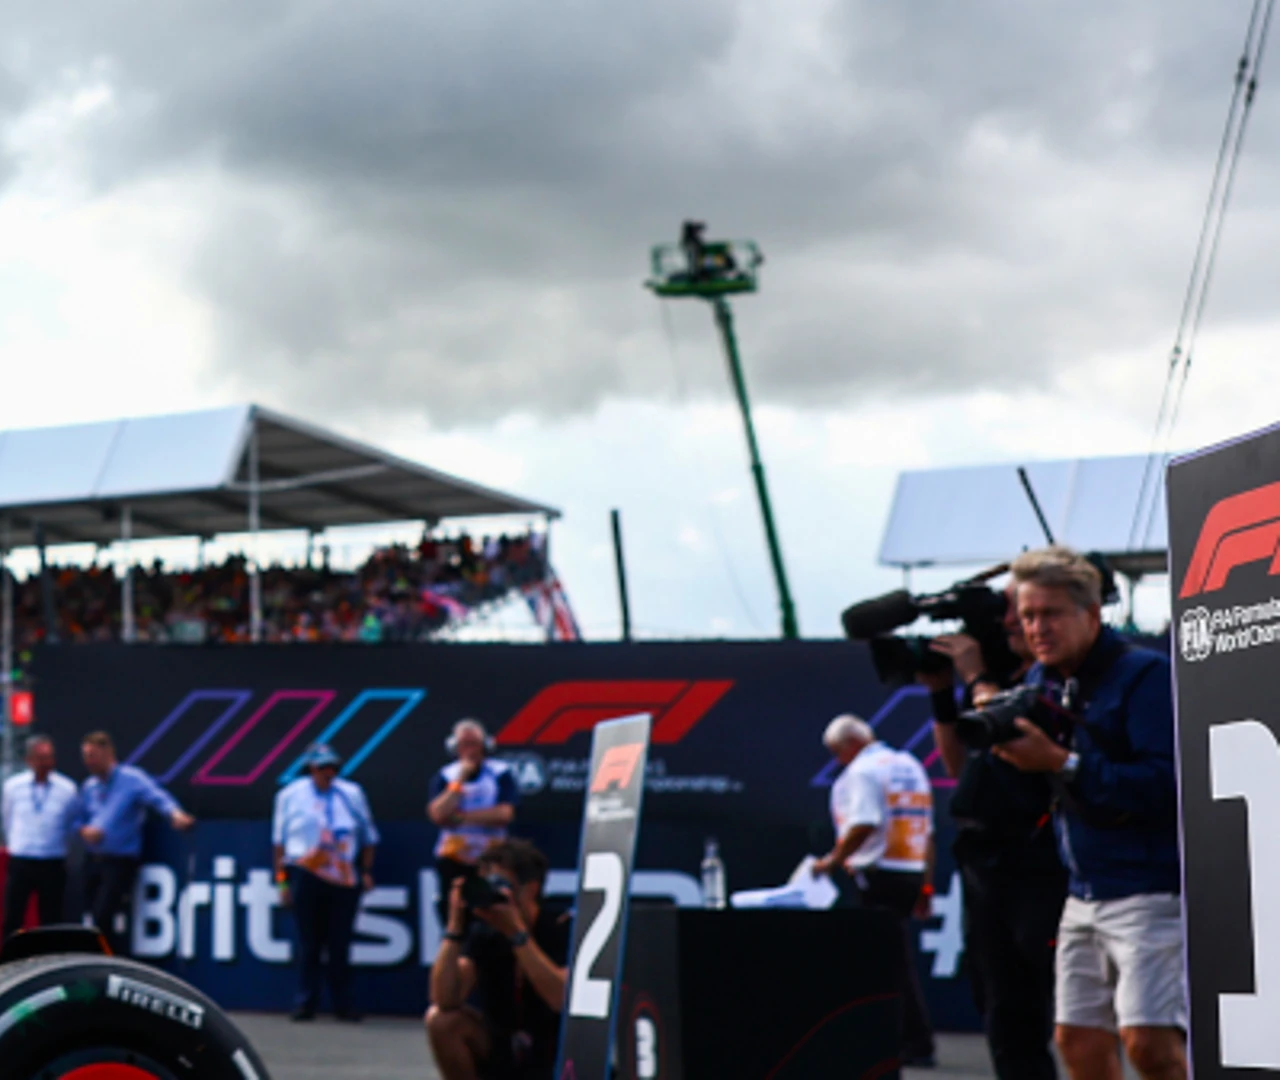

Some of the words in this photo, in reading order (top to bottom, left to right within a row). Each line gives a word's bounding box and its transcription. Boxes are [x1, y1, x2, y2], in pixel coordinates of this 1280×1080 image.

[132, 855, 444, 966] Brits
[568, 851, 624, 1019] 2
[1209, 719, 1280, 1070] 1
